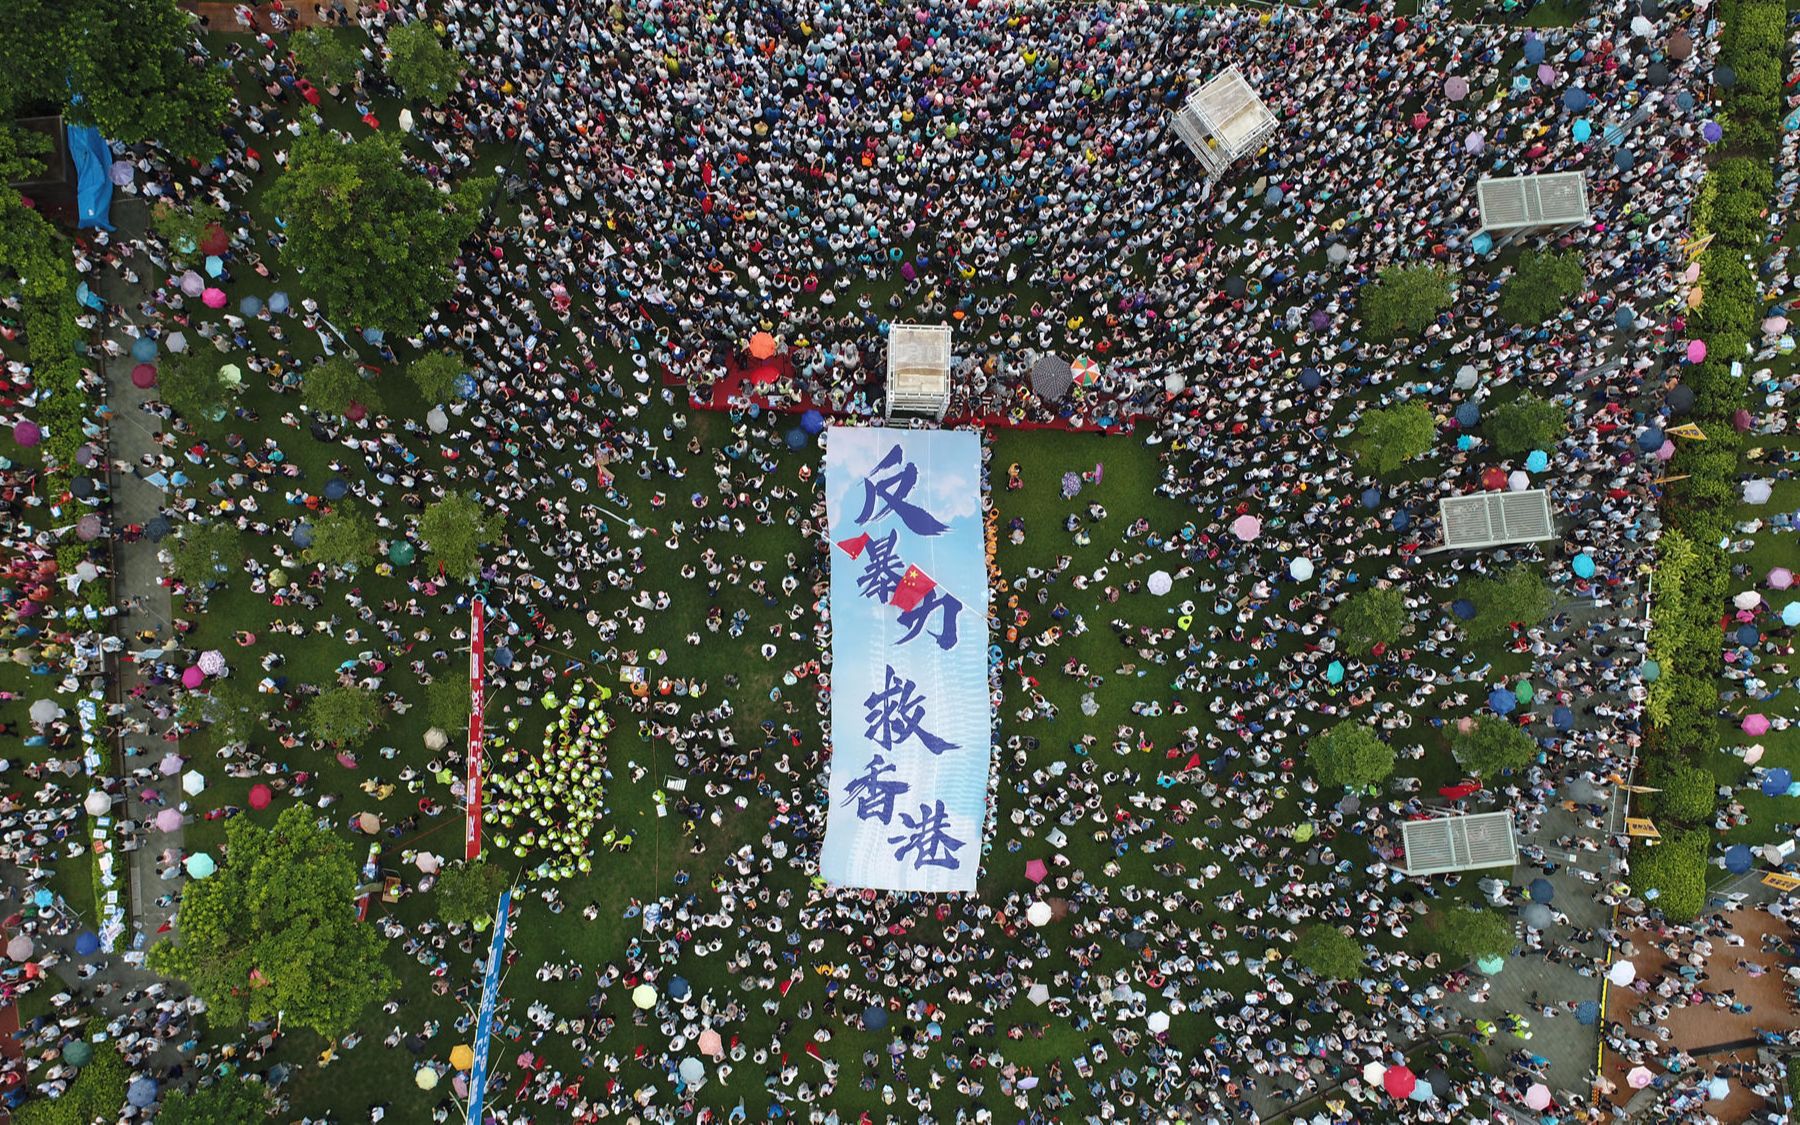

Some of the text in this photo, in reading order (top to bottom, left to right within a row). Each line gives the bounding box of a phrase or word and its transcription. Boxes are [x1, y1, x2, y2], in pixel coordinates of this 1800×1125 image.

[842, 444, 964, 871] 反暴力 救香港
